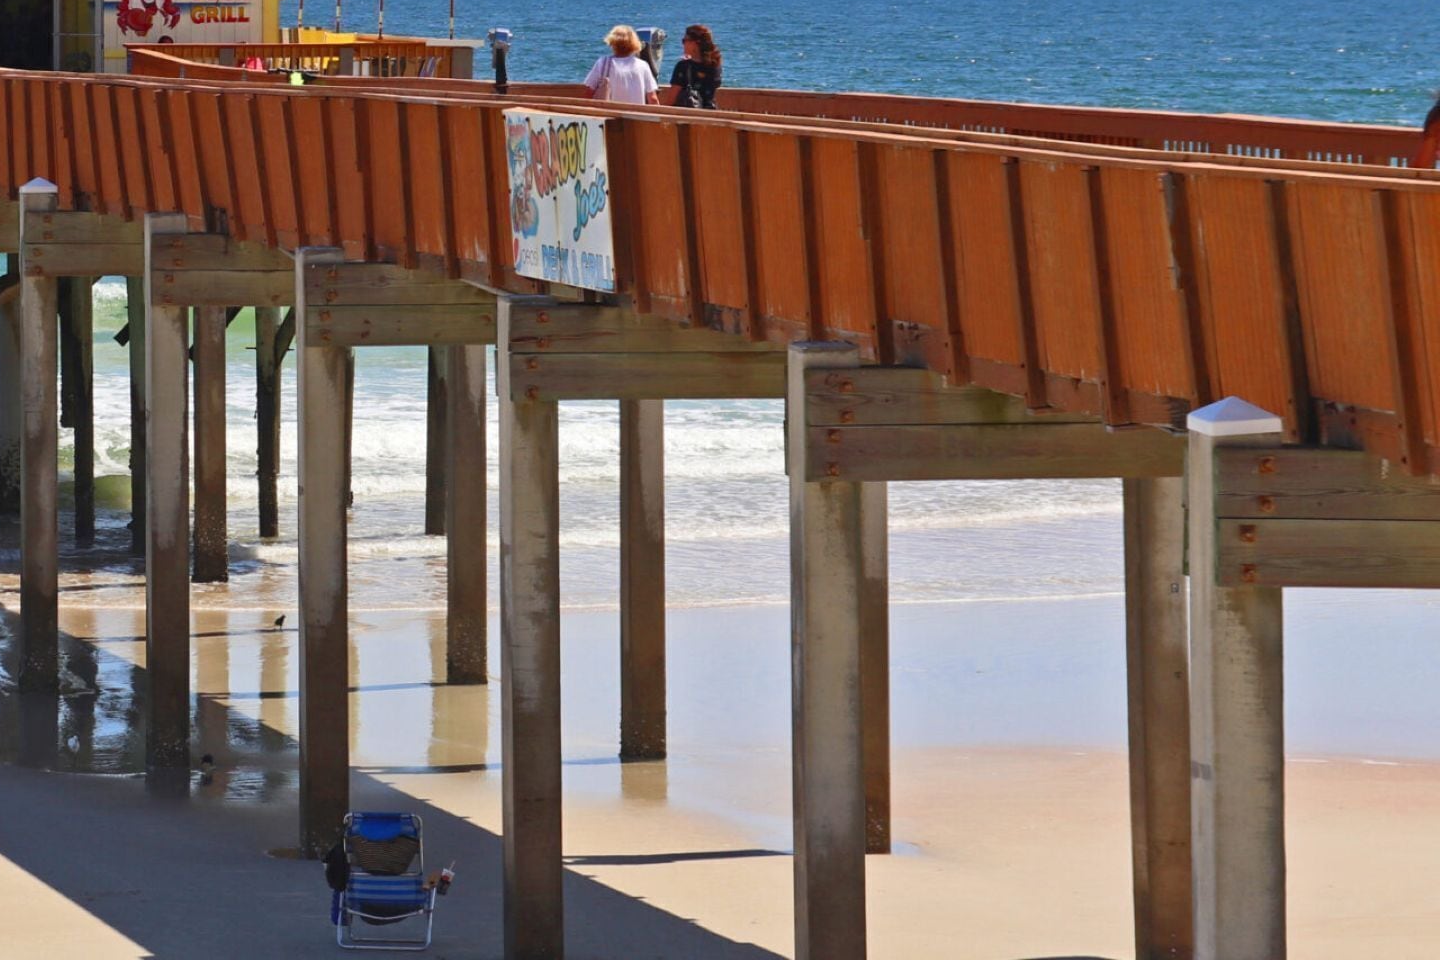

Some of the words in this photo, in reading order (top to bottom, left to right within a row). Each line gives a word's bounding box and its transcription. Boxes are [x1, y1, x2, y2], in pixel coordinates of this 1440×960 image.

[190, 5, 250, 24] GRILL
[530, 121, 588, 199] CRABBY
[541, 244, 570, 283] DECK
